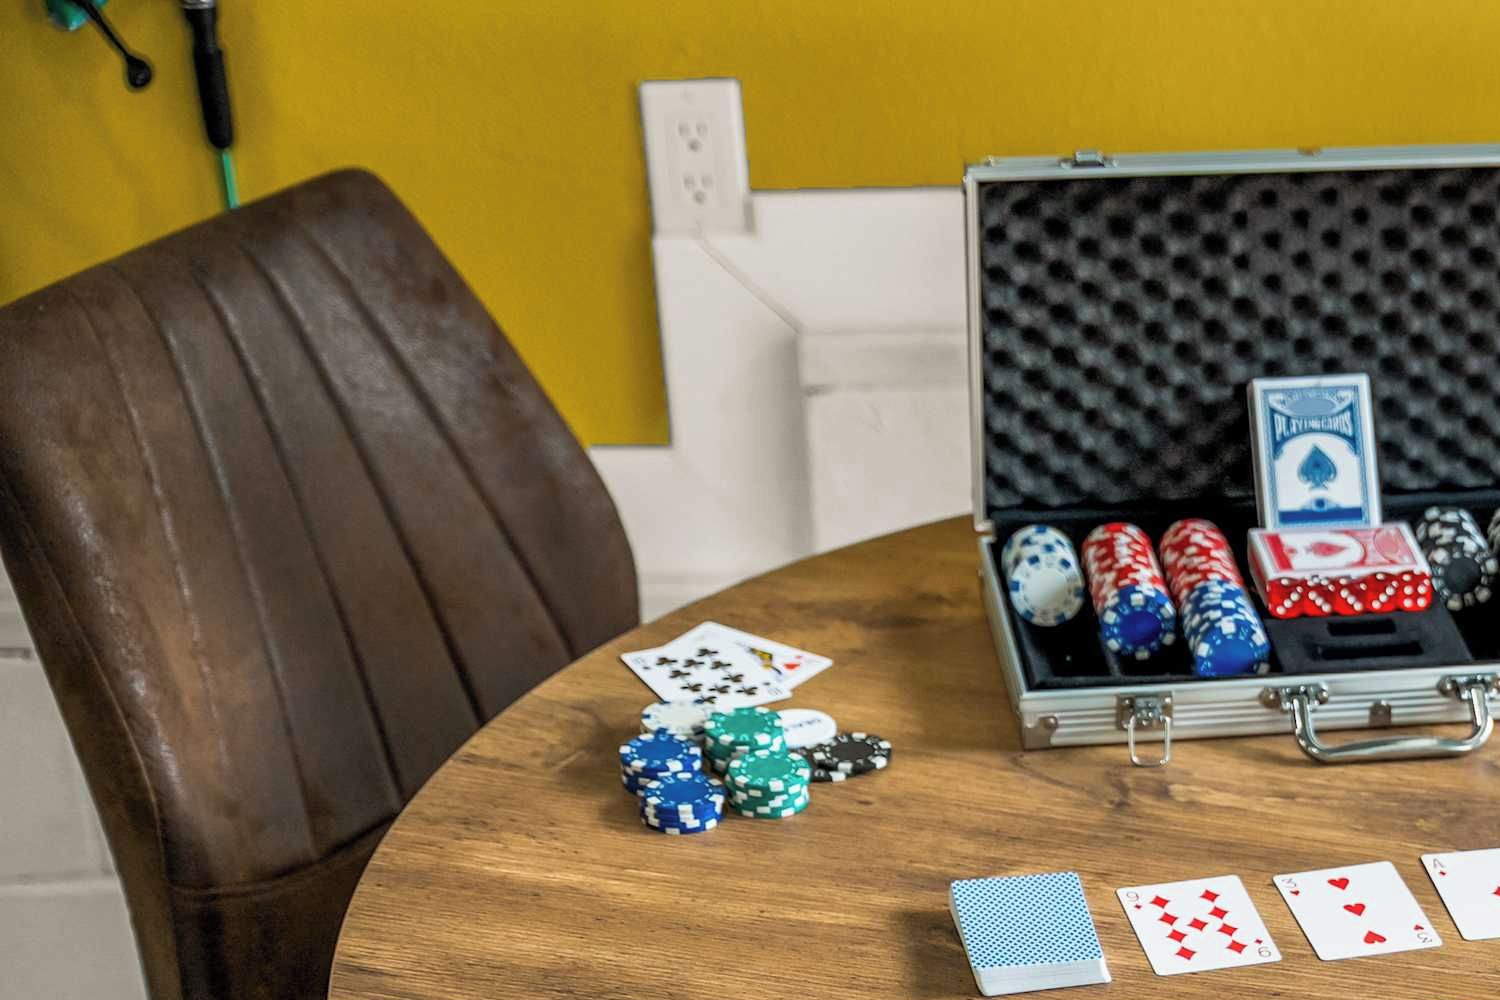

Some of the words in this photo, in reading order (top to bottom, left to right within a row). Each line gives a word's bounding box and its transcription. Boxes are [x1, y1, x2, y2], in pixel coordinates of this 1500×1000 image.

[1274, 413, 1320, 441] PLAYING
[1321, 410, 1353, 437] CARDS
[1281, 878, 1297, 889] 3
[1126, 891, 1140, 902] 9
